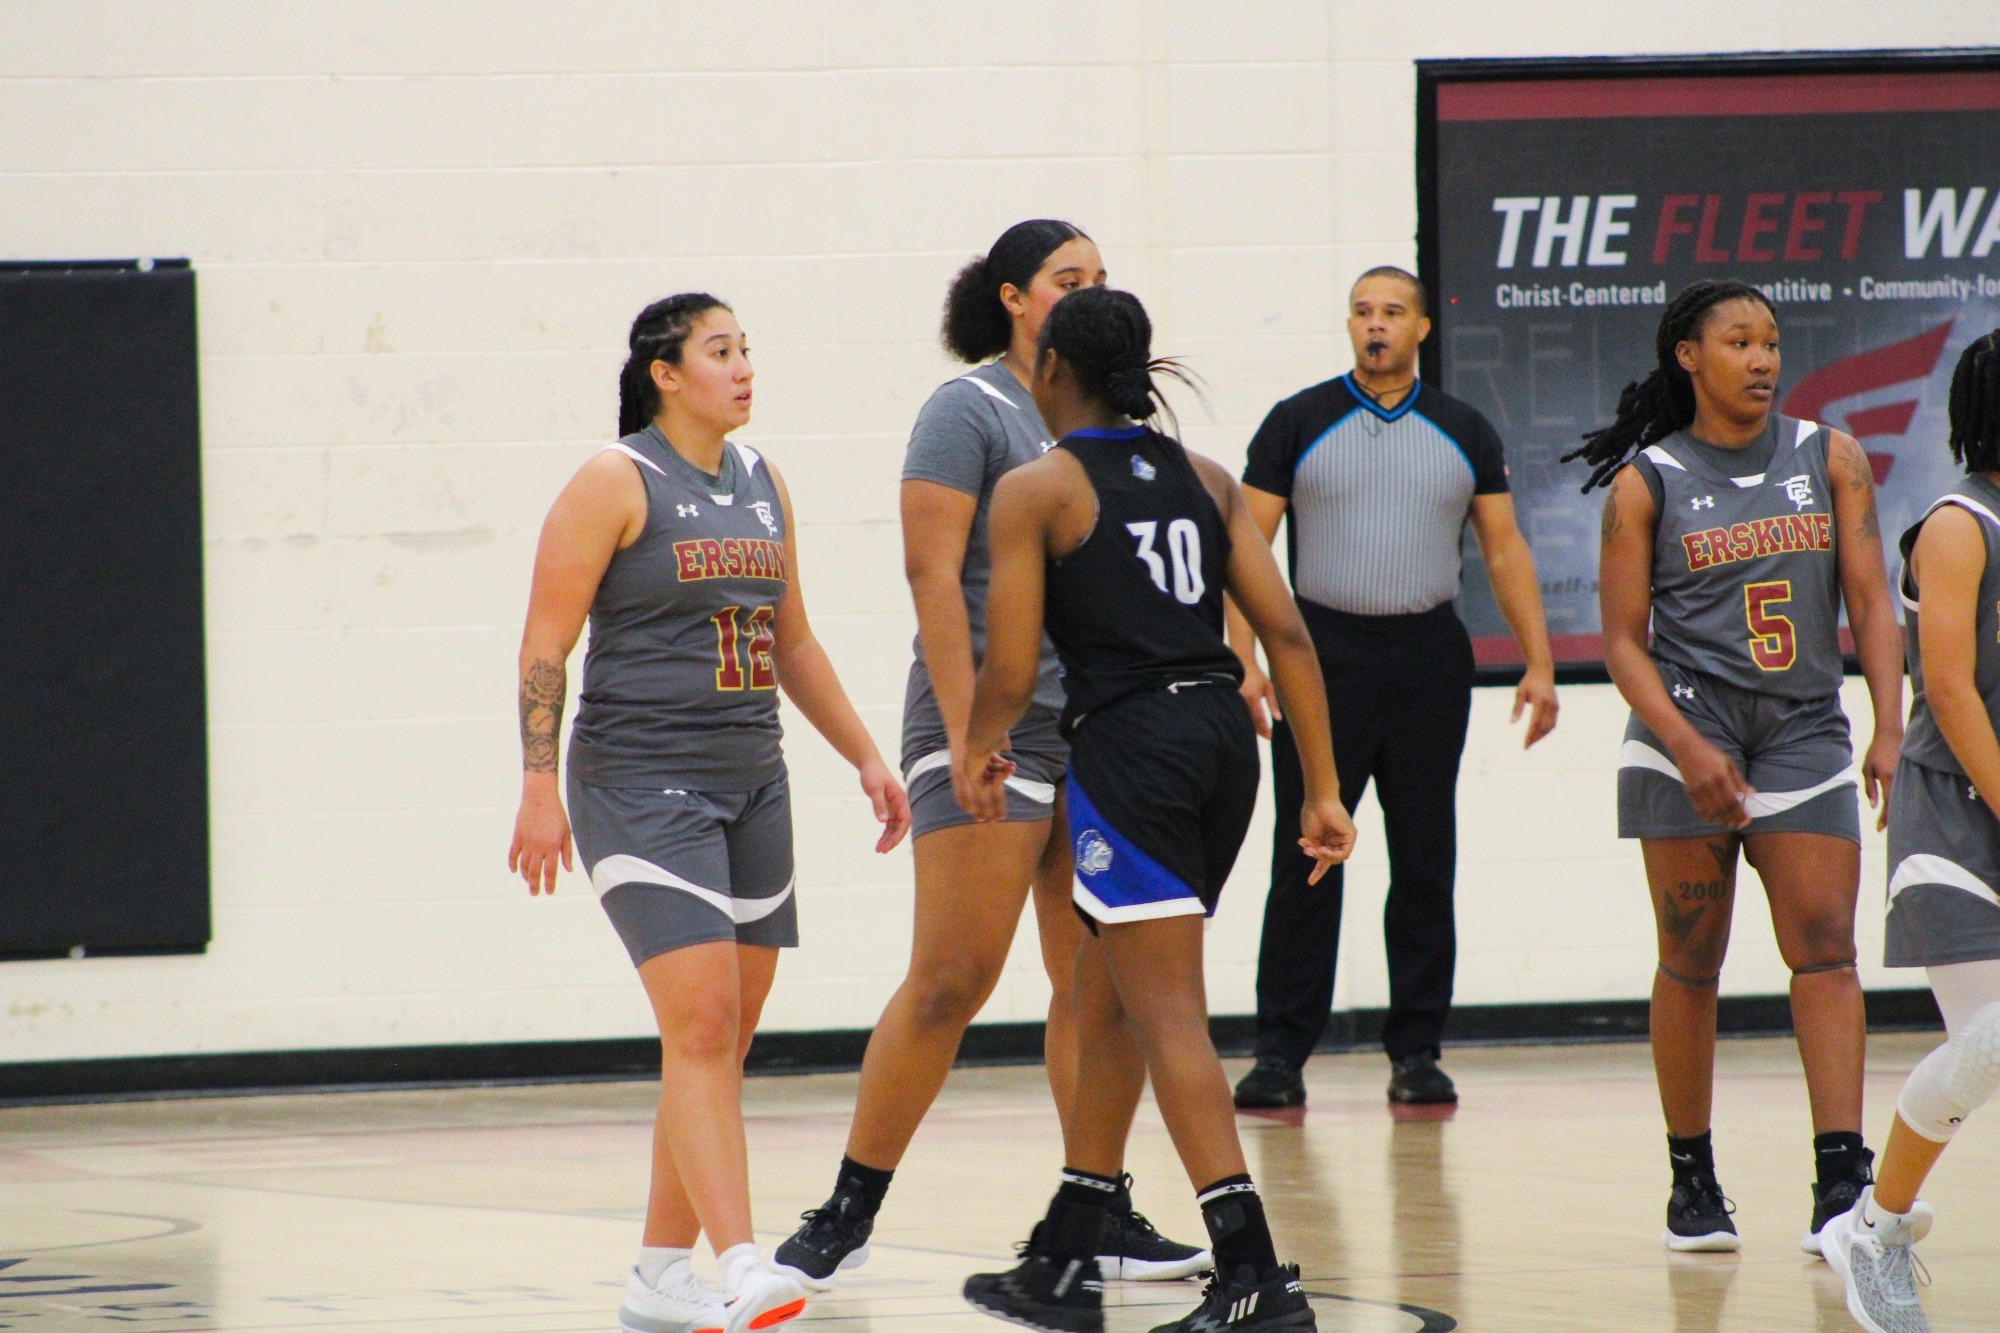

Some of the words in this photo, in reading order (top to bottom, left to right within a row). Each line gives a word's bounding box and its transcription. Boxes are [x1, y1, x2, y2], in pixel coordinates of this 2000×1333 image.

[1492, 194, 1638, 269] THE
[1651, 189, 1883, 265] FLEET
[1496, 280, 1666, 308] Christ-Centered
[1859, 273, 2000, 302] Community-fo
[1125, 518, 1205, 605] 30
[1682, 513, 1832, 572] ERSKINE
[710, 605, 777, 691] 12
[1744, 580, 1797, 671] 5
